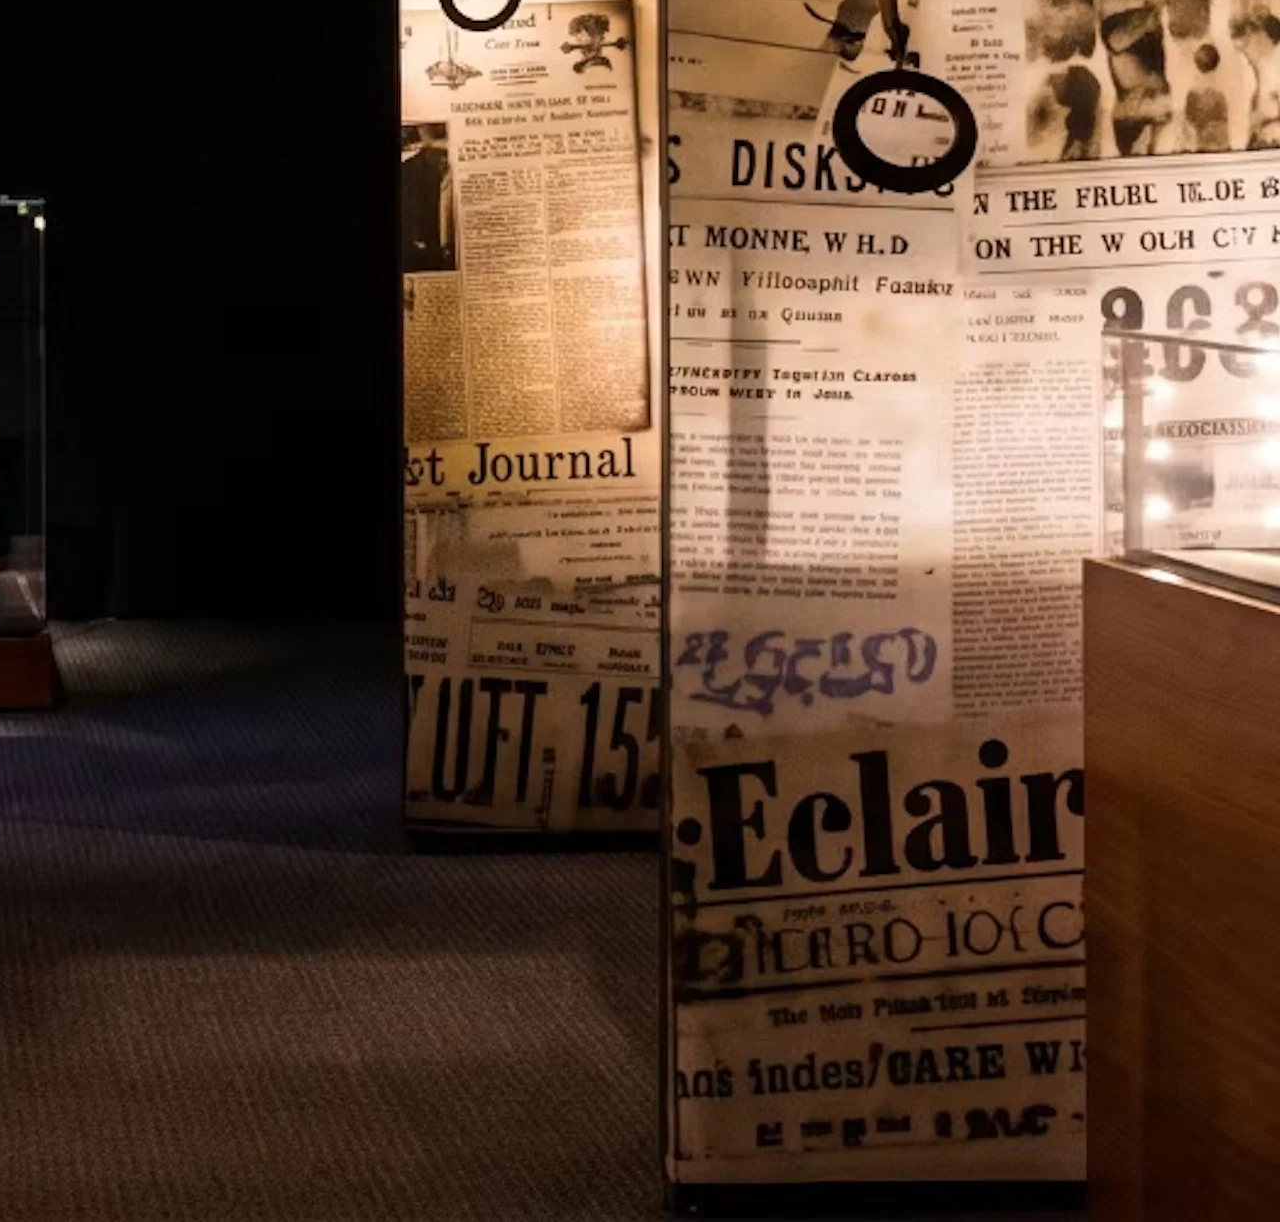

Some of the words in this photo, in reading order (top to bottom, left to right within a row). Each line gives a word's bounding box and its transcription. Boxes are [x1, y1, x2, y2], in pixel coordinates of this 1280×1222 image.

[1005, 189, 1058, 214] THE
[975, 238, 1011, 261] ON
[1029, 235, 1083, 258] THE
[468, 436, 637, 486] Journal
